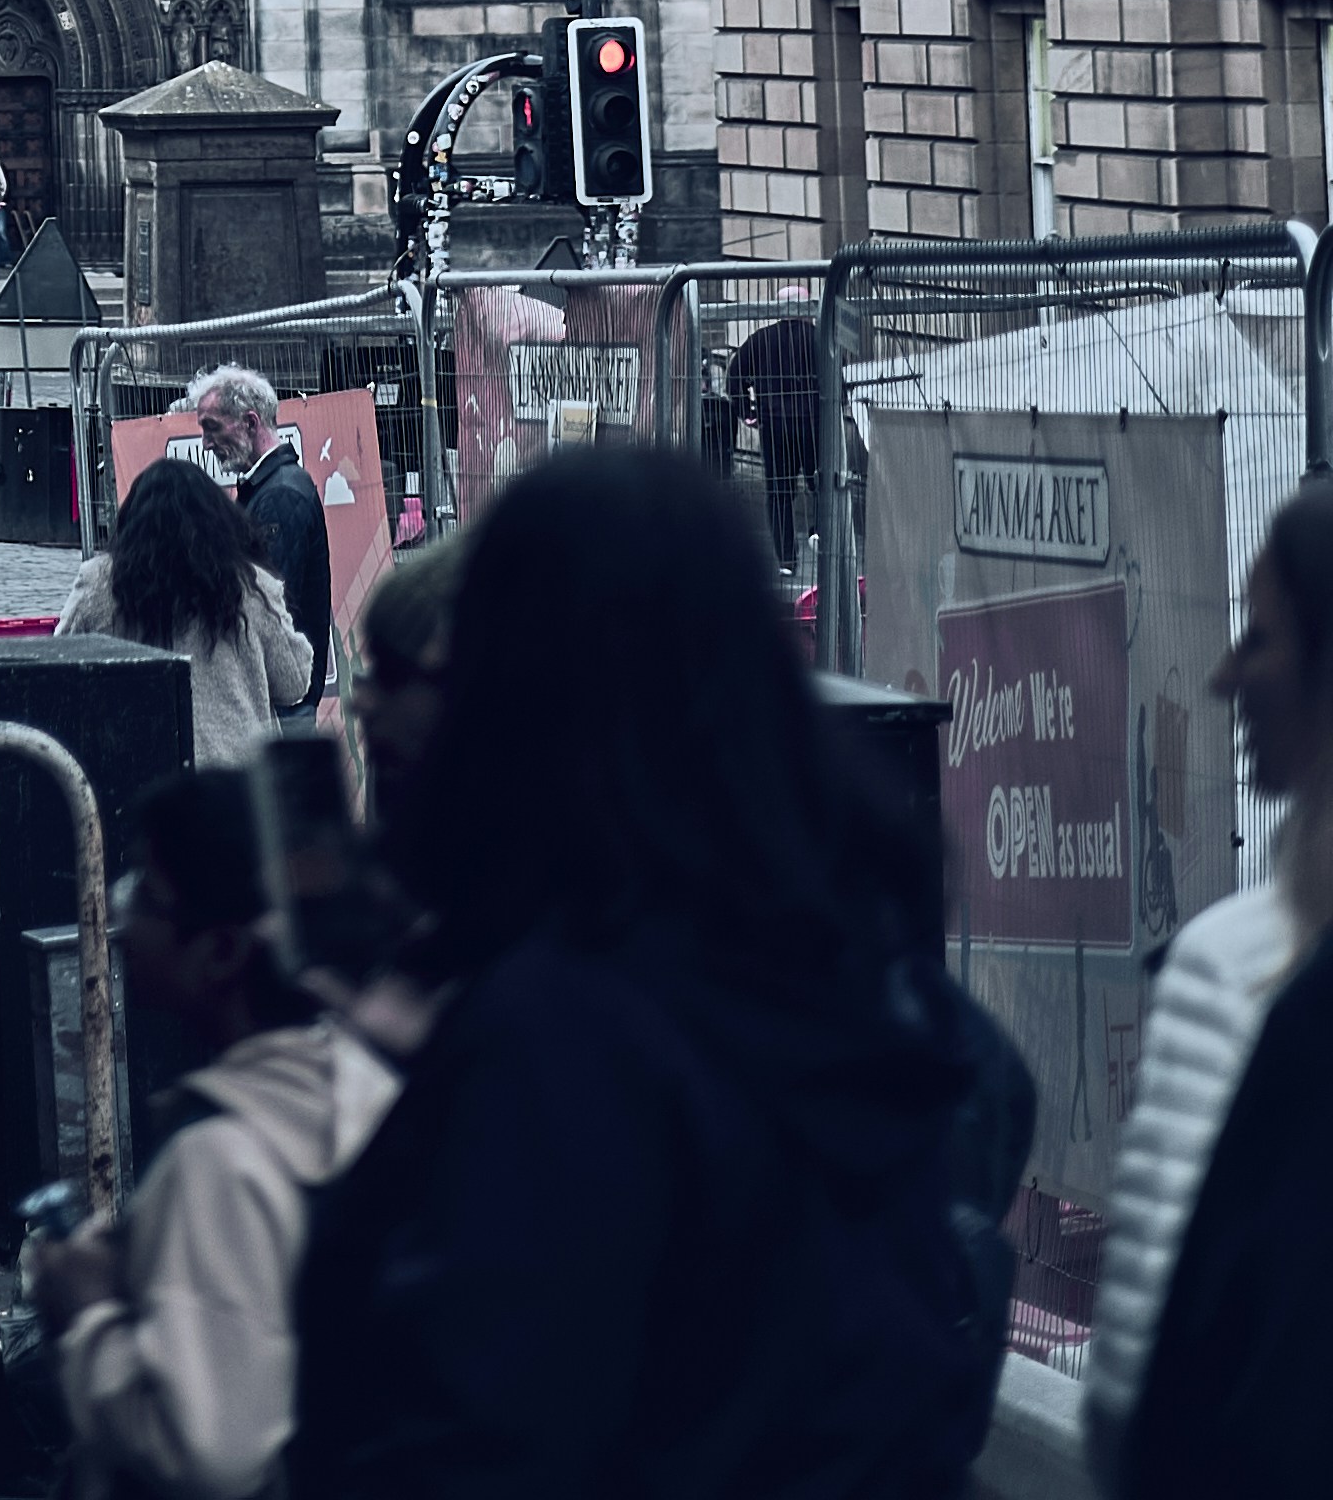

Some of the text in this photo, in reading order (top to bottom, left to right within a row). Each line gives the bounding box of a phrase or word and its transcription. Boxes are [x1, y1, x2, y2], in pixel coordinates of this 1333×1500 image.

[958, 469, 1099, 546] LAWNMARKET
[947, 658, 1074, 768] Welcome We're
[986, 785, 1123, 879] OPEN as usual
